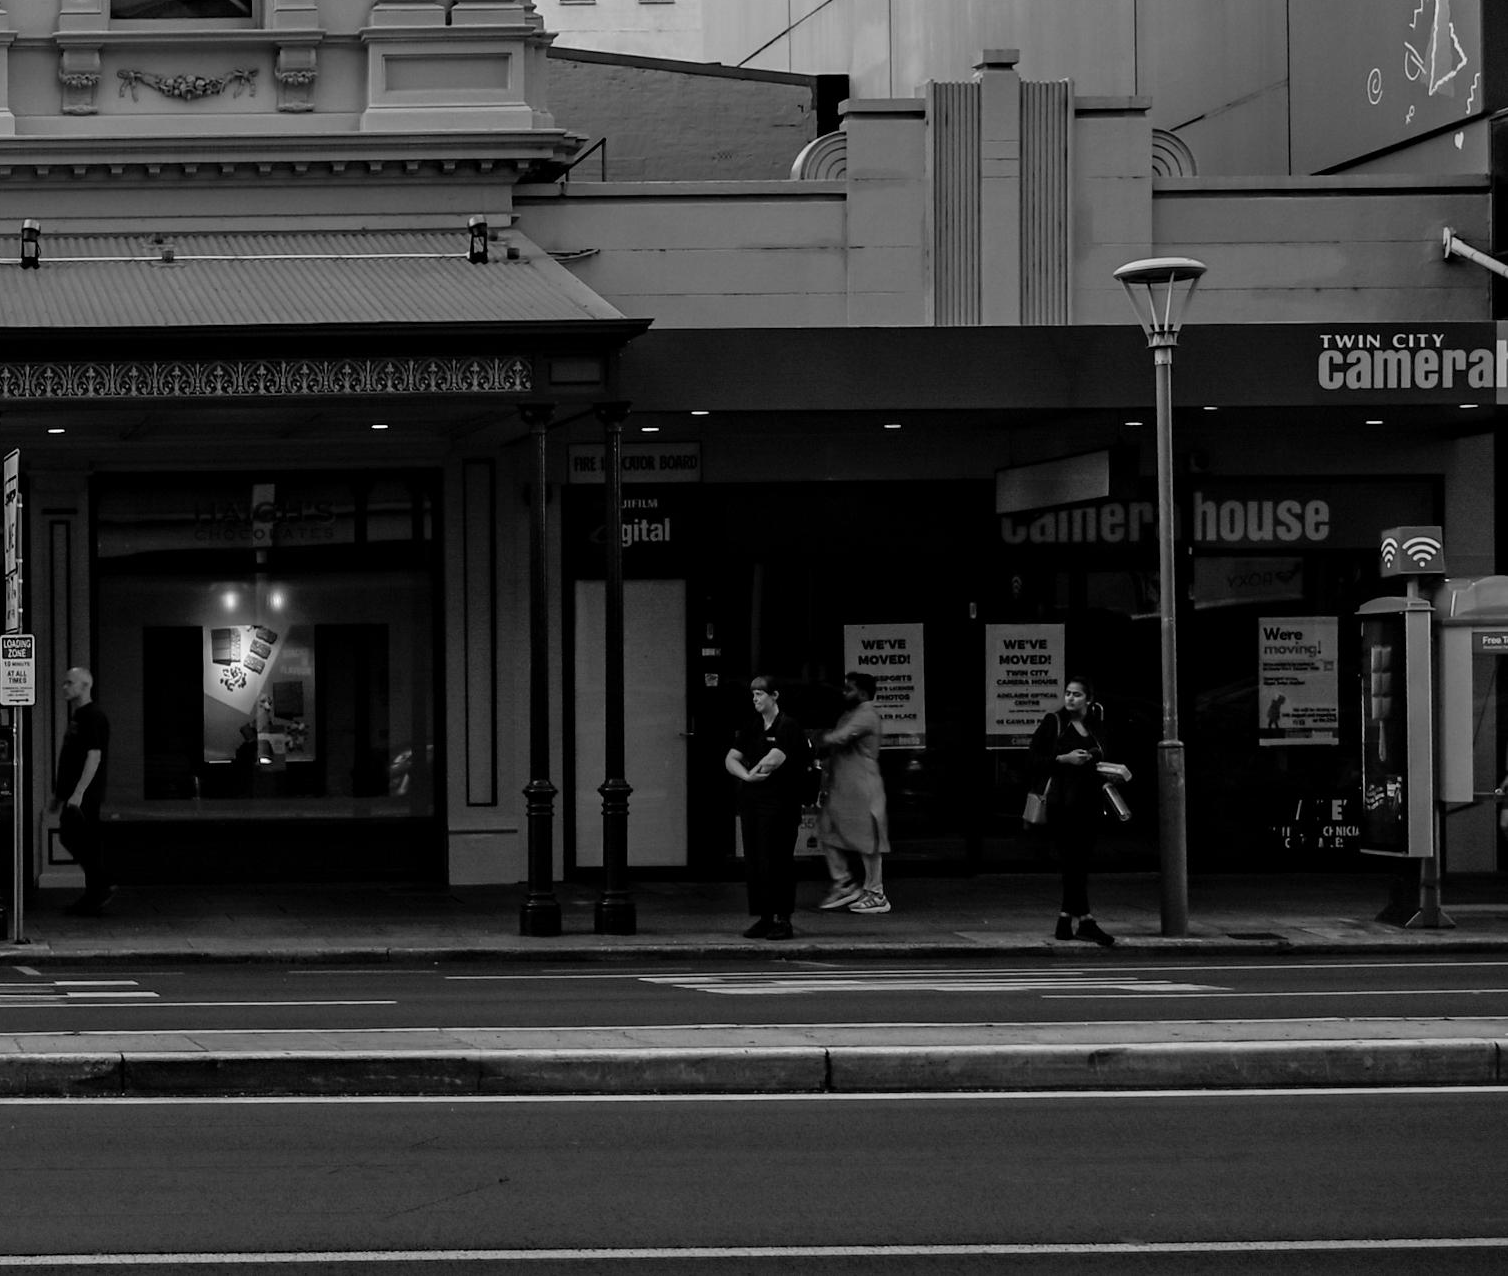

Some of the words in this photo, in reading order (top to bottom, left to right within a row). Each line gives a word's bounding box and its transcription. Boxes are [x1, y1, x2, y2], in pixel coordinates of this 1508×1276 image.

[1319, 334, 1381, 349] TWIN
[1392, 333, 1445, 348] CITY
[574, 457, 597, 471] FIRE
[600, 455, 656, 470] ICATOR
[659, 455, 698, 469] BOARD
[621, 499, 659, 510] JIFILM
[1001, 501, 1183, 546] camer
[1193, 490, 1330, 542] house
[621, 517, 671, 548] gital
[1264, 628, 1303, 640] Were
[1482, 635, 1502, 644] Free
[3, 639, 32, 648] LOADING
[862, 639, 906, 650] WE'VE
[1003, 639, 1047, 650] WE'VE
[1264, 640, 1322, 657] moving!
[8, 649, 27, 658] ZONE
[858, 654, 911, 665] MOVED!
[999, 654, 1052, 665] MOVED!
